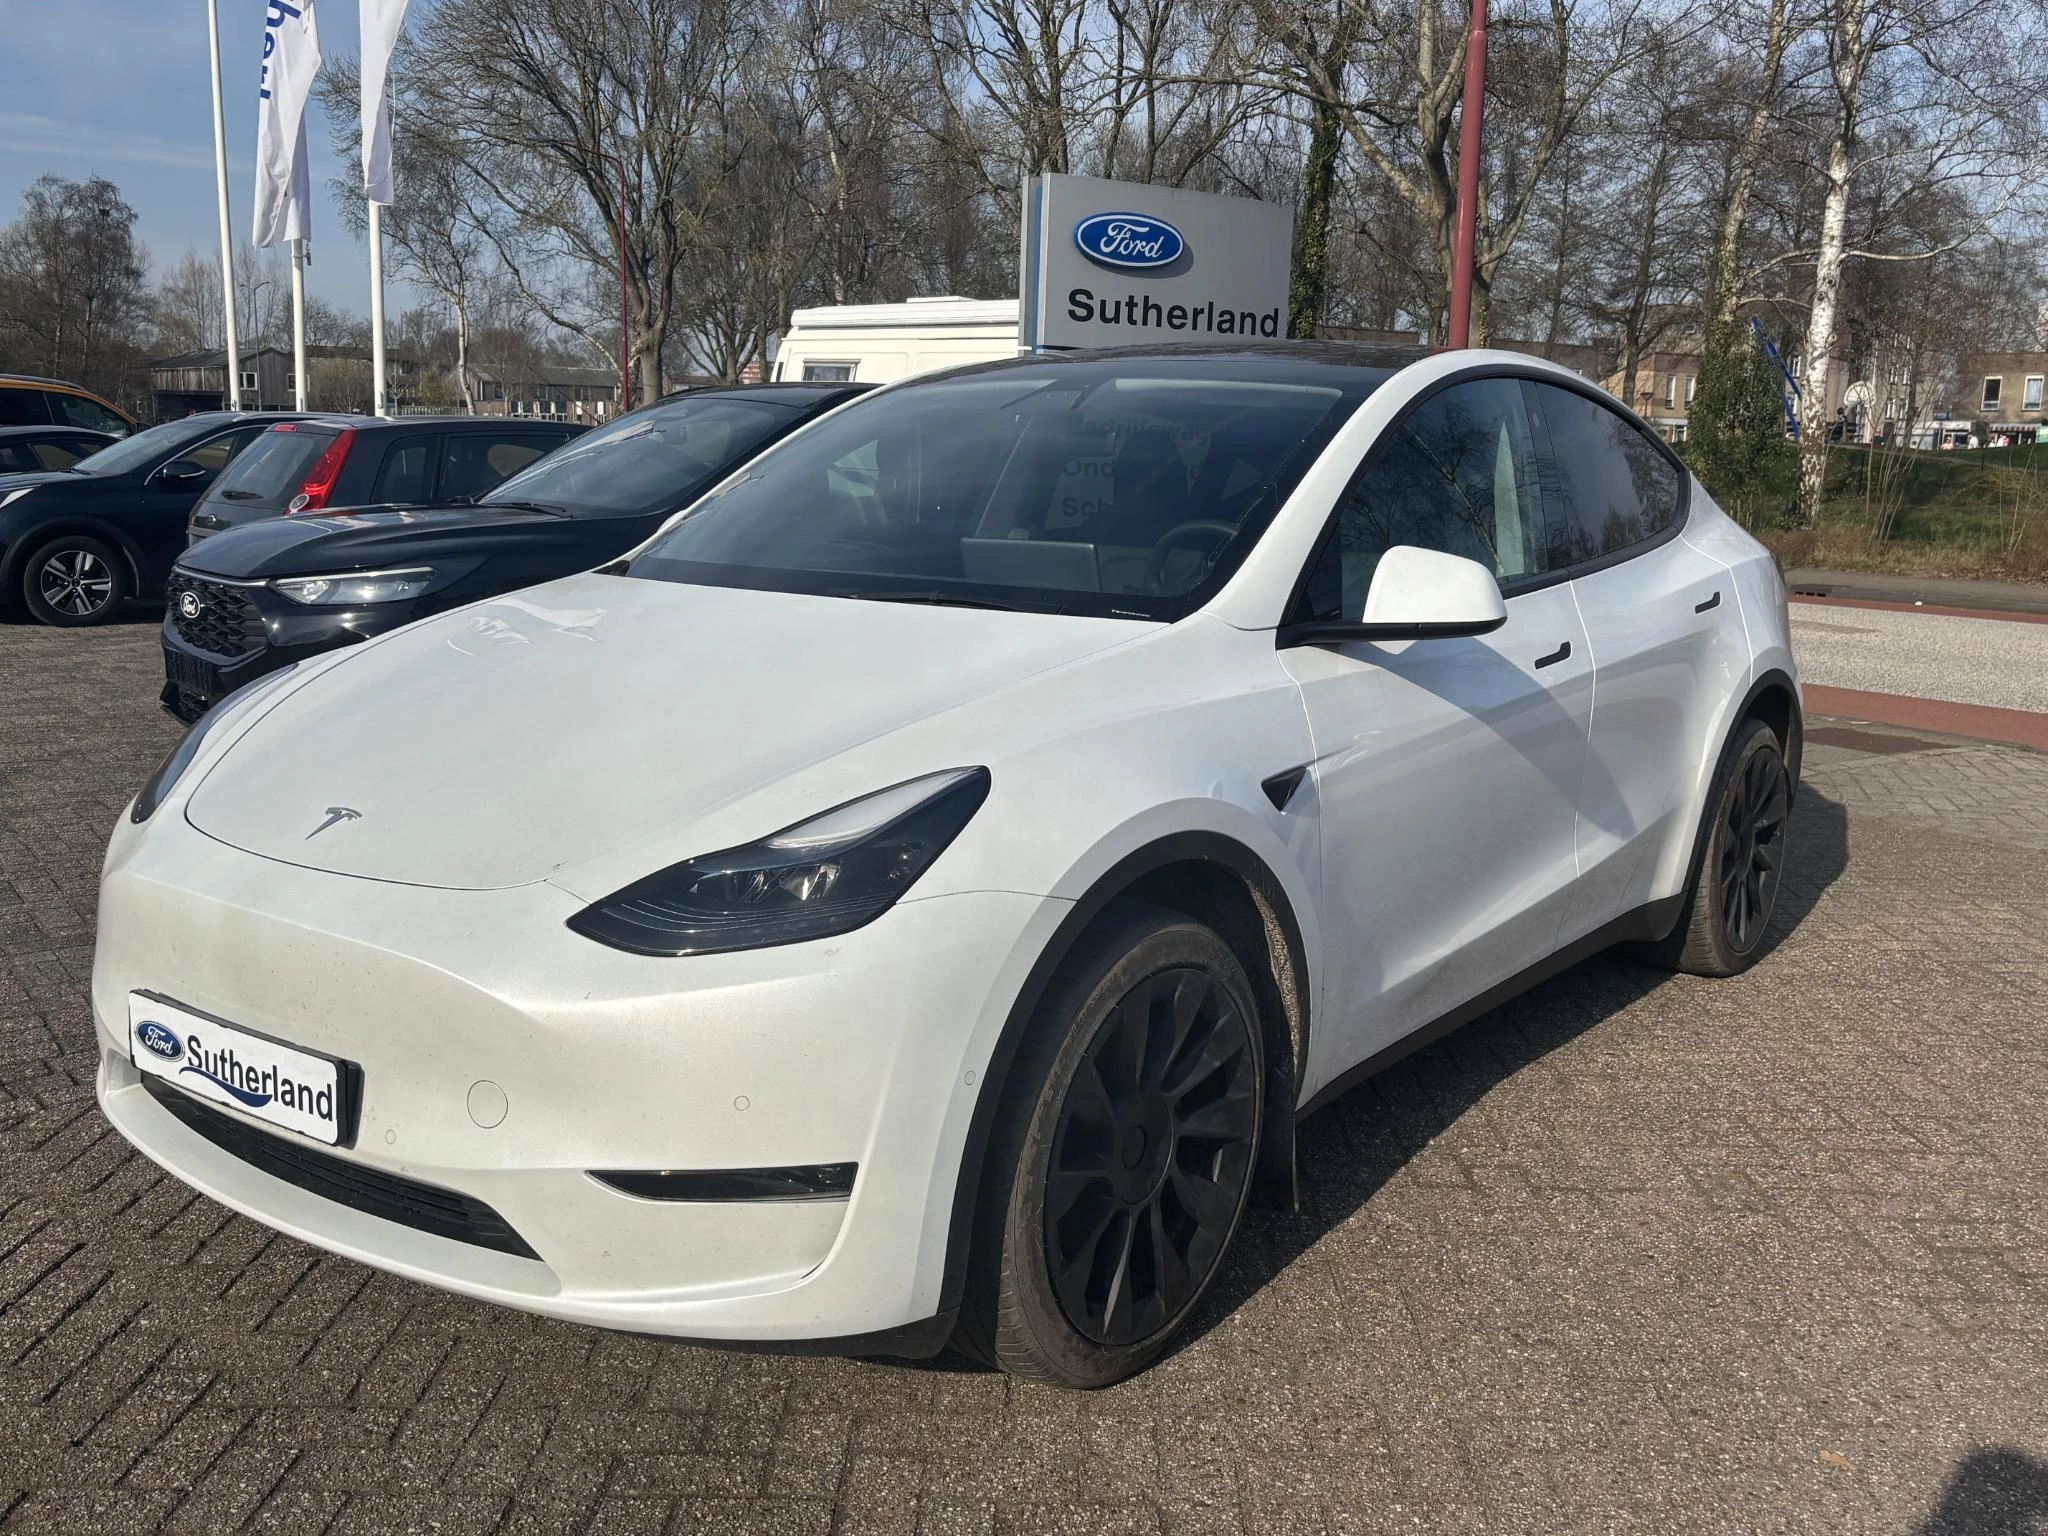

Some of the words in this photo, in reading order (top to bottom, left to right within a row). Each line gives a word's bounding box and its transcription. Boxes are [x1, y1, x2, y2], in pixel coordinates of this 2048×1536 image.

[1100, 221, 1164, 258] Ford
[1068, 289, 1279, 337] Sutherland
[145, 1025, 173, 1055] Ford
[187, 1035, 333, 1121] Sutherland
